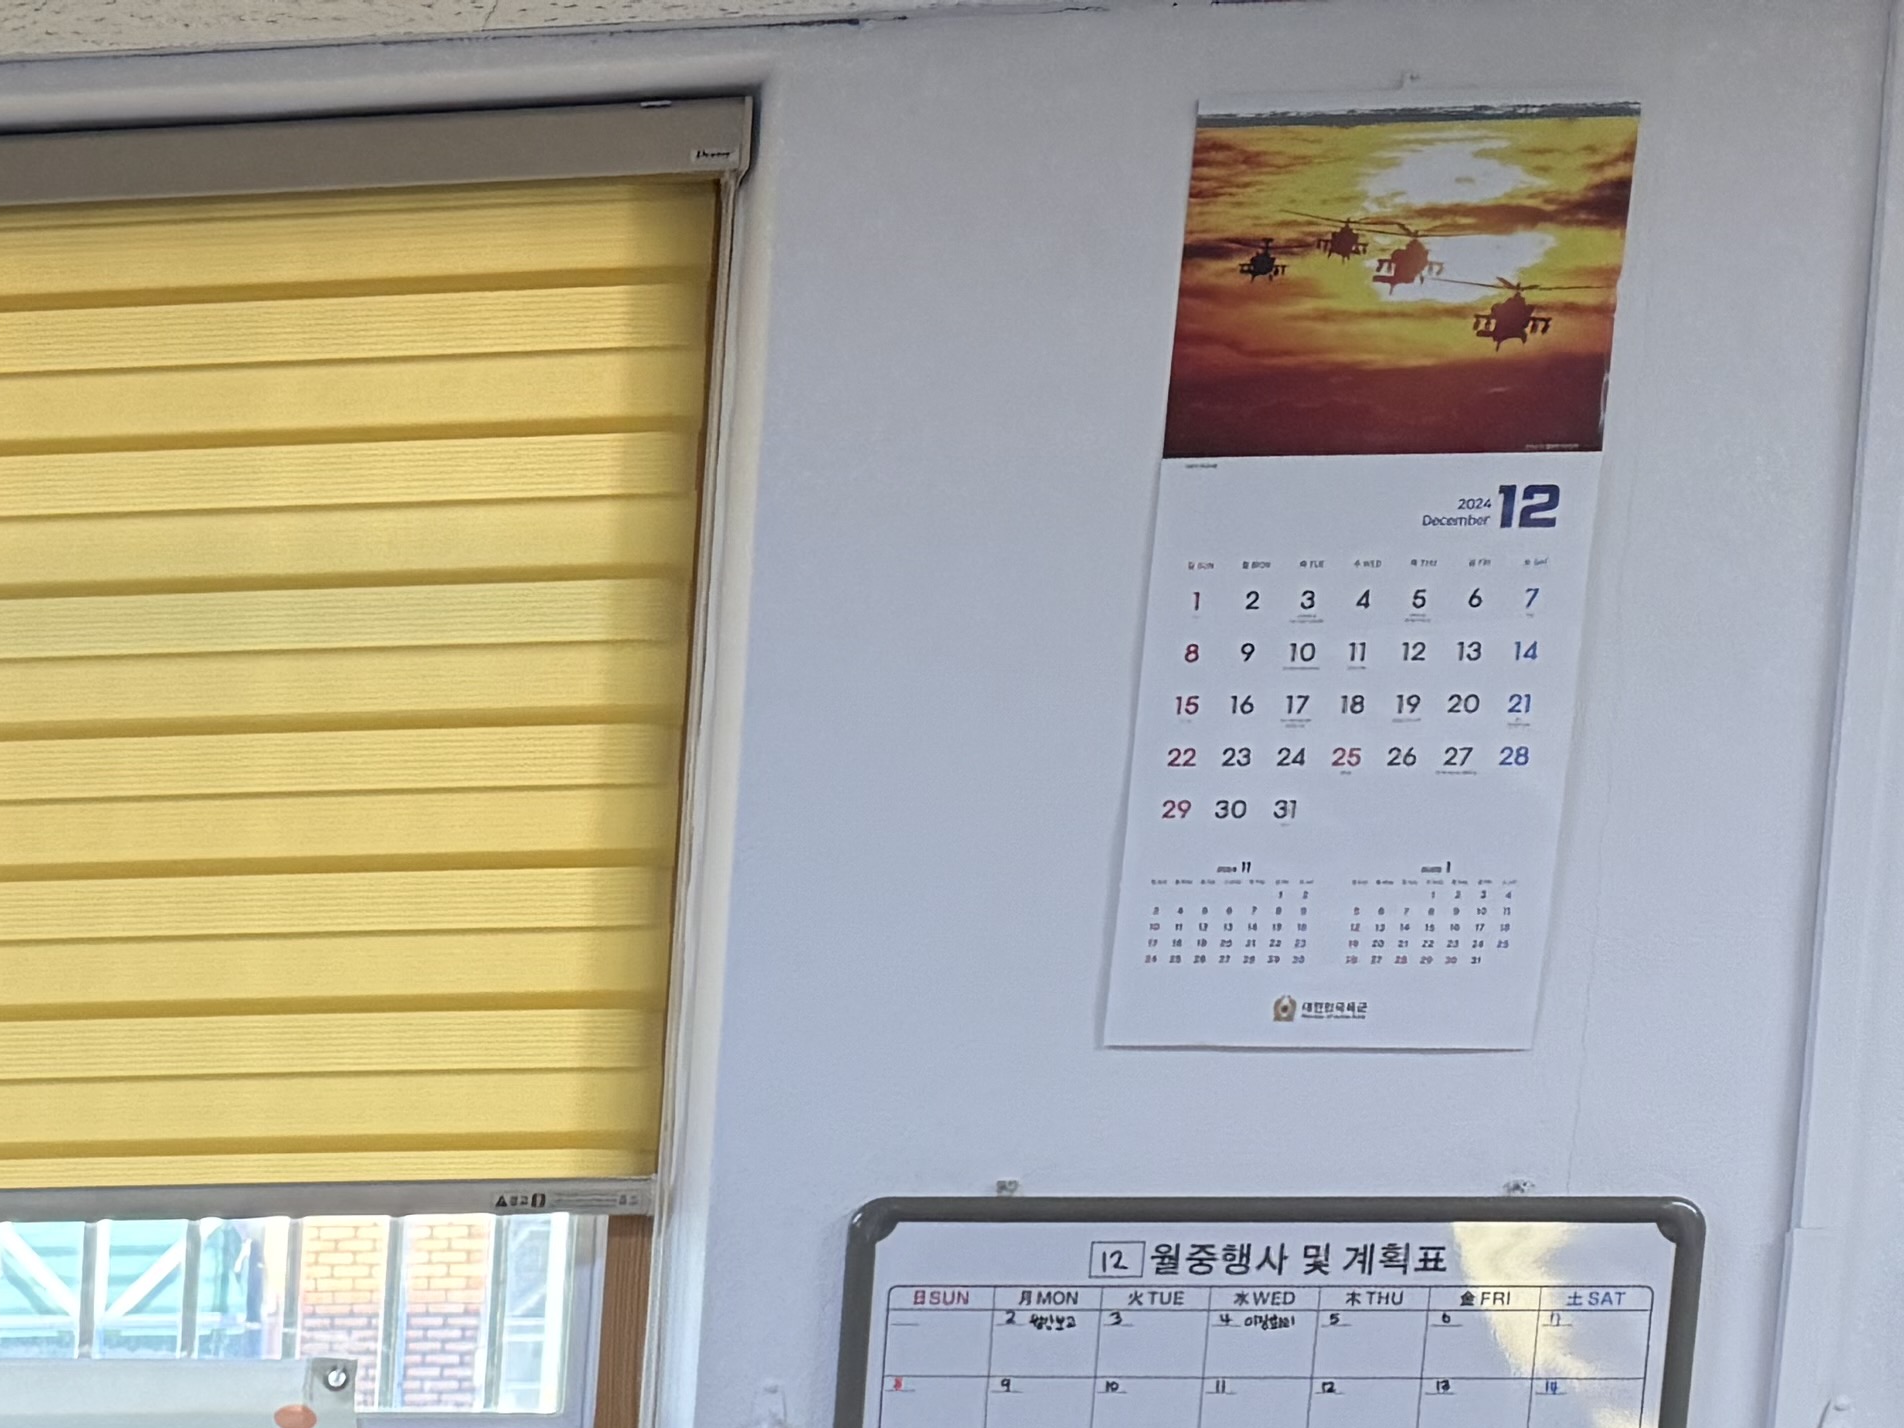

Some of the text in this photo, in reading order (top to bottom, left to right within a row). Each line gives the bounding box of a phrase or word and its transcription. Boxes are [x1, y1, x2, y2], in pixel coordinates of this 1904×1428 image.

[1457, 484, 1561, 529] 2024 12
[1422, 513, 1491, 528] December
[1193, 587, 1540, 611] 1 2 3 4 5 6 7
[1184, 640, 1538, 664] 8 9 10 11 12 13 14
[1175, 693, 1531, 716] 15 16 17 18 19 20 21
[1167, 746, 1529, 767] 22 23 24 25 26 27 28
[1161, 799, 1297, 819] 29 30 31
[1101, 1250, 1129, 1273] 12
[1150, 1242, 1448, 1275] 월중행사 및 계획표
[929, 1290, 970, 1305] SUN
[1037, 1290, 1079, 1305] MON
[1147, 1291, 1185, 1306] TUE
[1253, 1291, 1296, 1305] WED
[1366, 1291, 1404, 1306] THU
[1480, 1291, 1511, 1306] FRI
[1588, 1291, 1626, 1306] SAT
[1005, 1310, 1017, 1324] 2
[1109, 1311, 1122, 1325] 3
[1219, 1313, 1232, 1325] 4
[1329, 1312, 1341, 1325] 5
[1000, 1378, 1012, 1392] 9
[1105, 1380, 1120, 1392] 10
[1215, 1379, 1226, 1393] 11
[1321, 1381, 1336, 1393] 12
